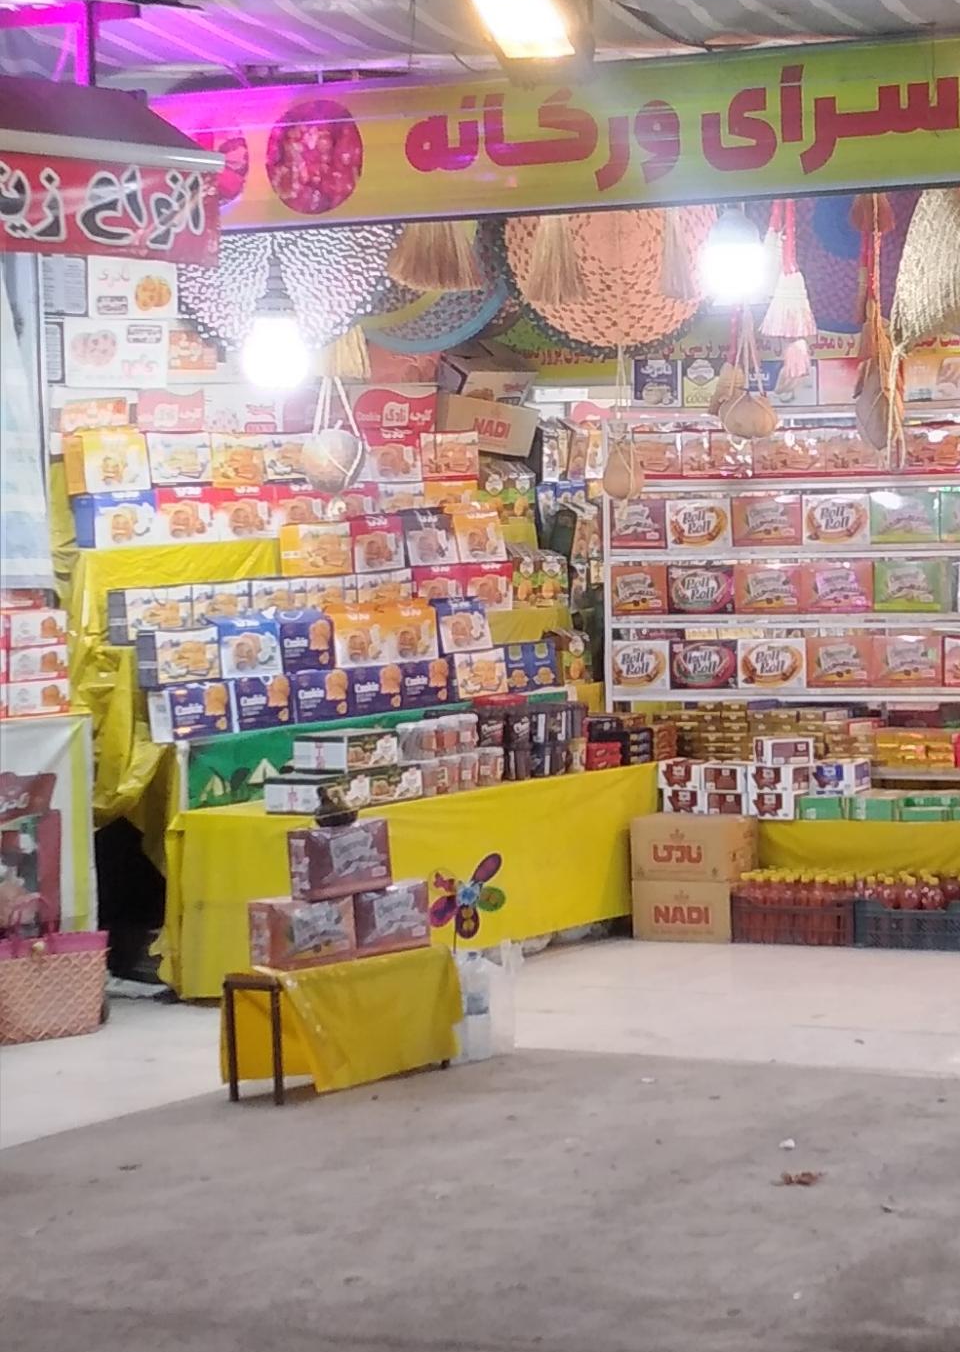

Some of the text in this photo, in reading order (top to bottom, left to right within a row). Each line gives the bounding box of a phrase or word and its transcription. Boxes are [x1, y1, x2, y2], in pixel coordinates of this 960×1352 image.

[405, 88, 681, 192] ورکانه
[701, 63, 960, 175] سرای
[77, 166, 204, 249] انواع
[474, 417, 511, 439] NADI
[654, 906, 710, 925] NADI
